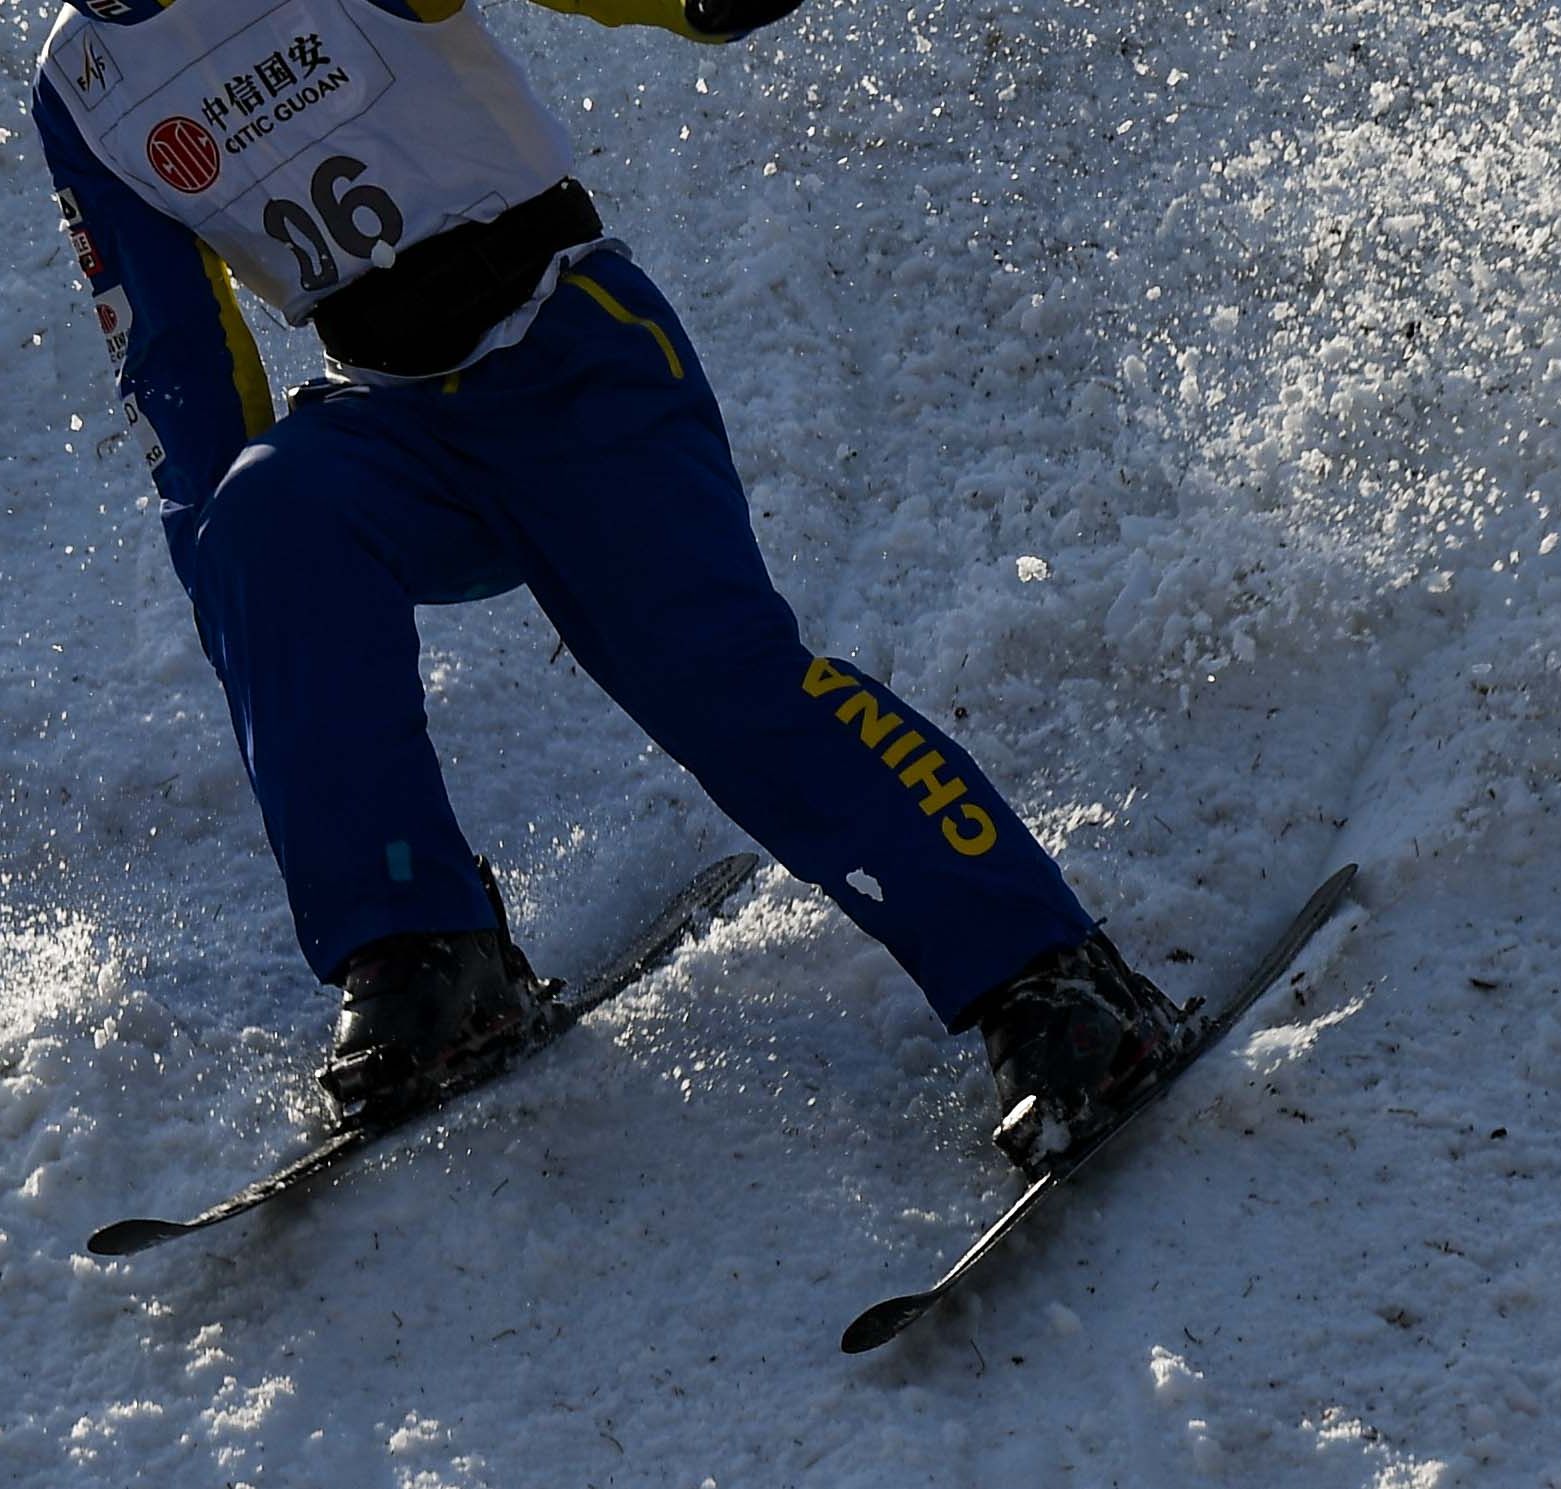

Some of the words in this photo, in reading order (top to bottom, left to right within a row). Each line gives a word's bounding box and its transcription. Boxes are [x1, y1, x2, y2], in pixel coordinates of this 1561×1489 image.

[202, 33, 331, 131] 中信国安
[225, 115, 274, 154] CITIC
[274, 67, 349, 121] GUOAN
[801, 657, 998, 856] CHINA
